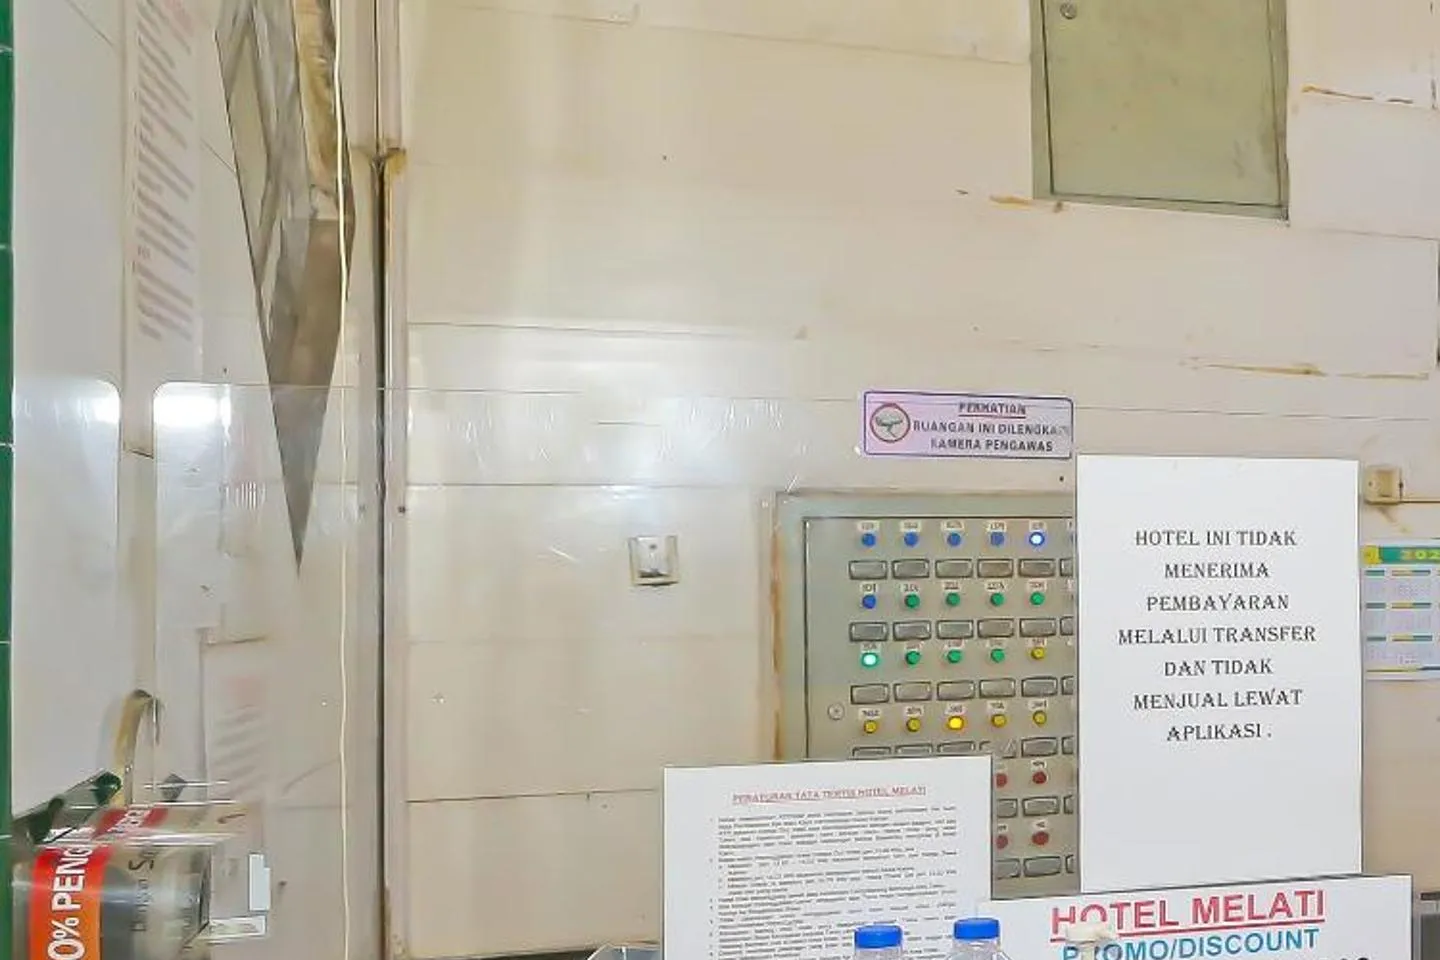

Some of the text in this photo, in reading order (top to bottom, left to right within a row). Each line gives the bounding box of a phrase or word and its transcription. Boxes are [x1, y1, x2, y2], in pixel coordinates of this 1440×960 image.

[913, 420, 974, 433] RUANGAN
[979, 422, 995, 434] INI
[931, 438, 1053, 452] KAMERA PENGAWAS
[1135, 530, 1298, 546] HOTEL INI TIDAK
[1164, 563, 1270, 579] MENERIMA
[1147, 593, 1289, 611] PEMBAYARAN
[1118, 626, 1318, 645] MELALUI TRANSFER
[1164, 658, 1274, 677] DAN TIDAK
[1133, 688, 1304, 710] MENJUAL LEWAT
[1051, 890, 1324, 934] HOTEL MELATI
